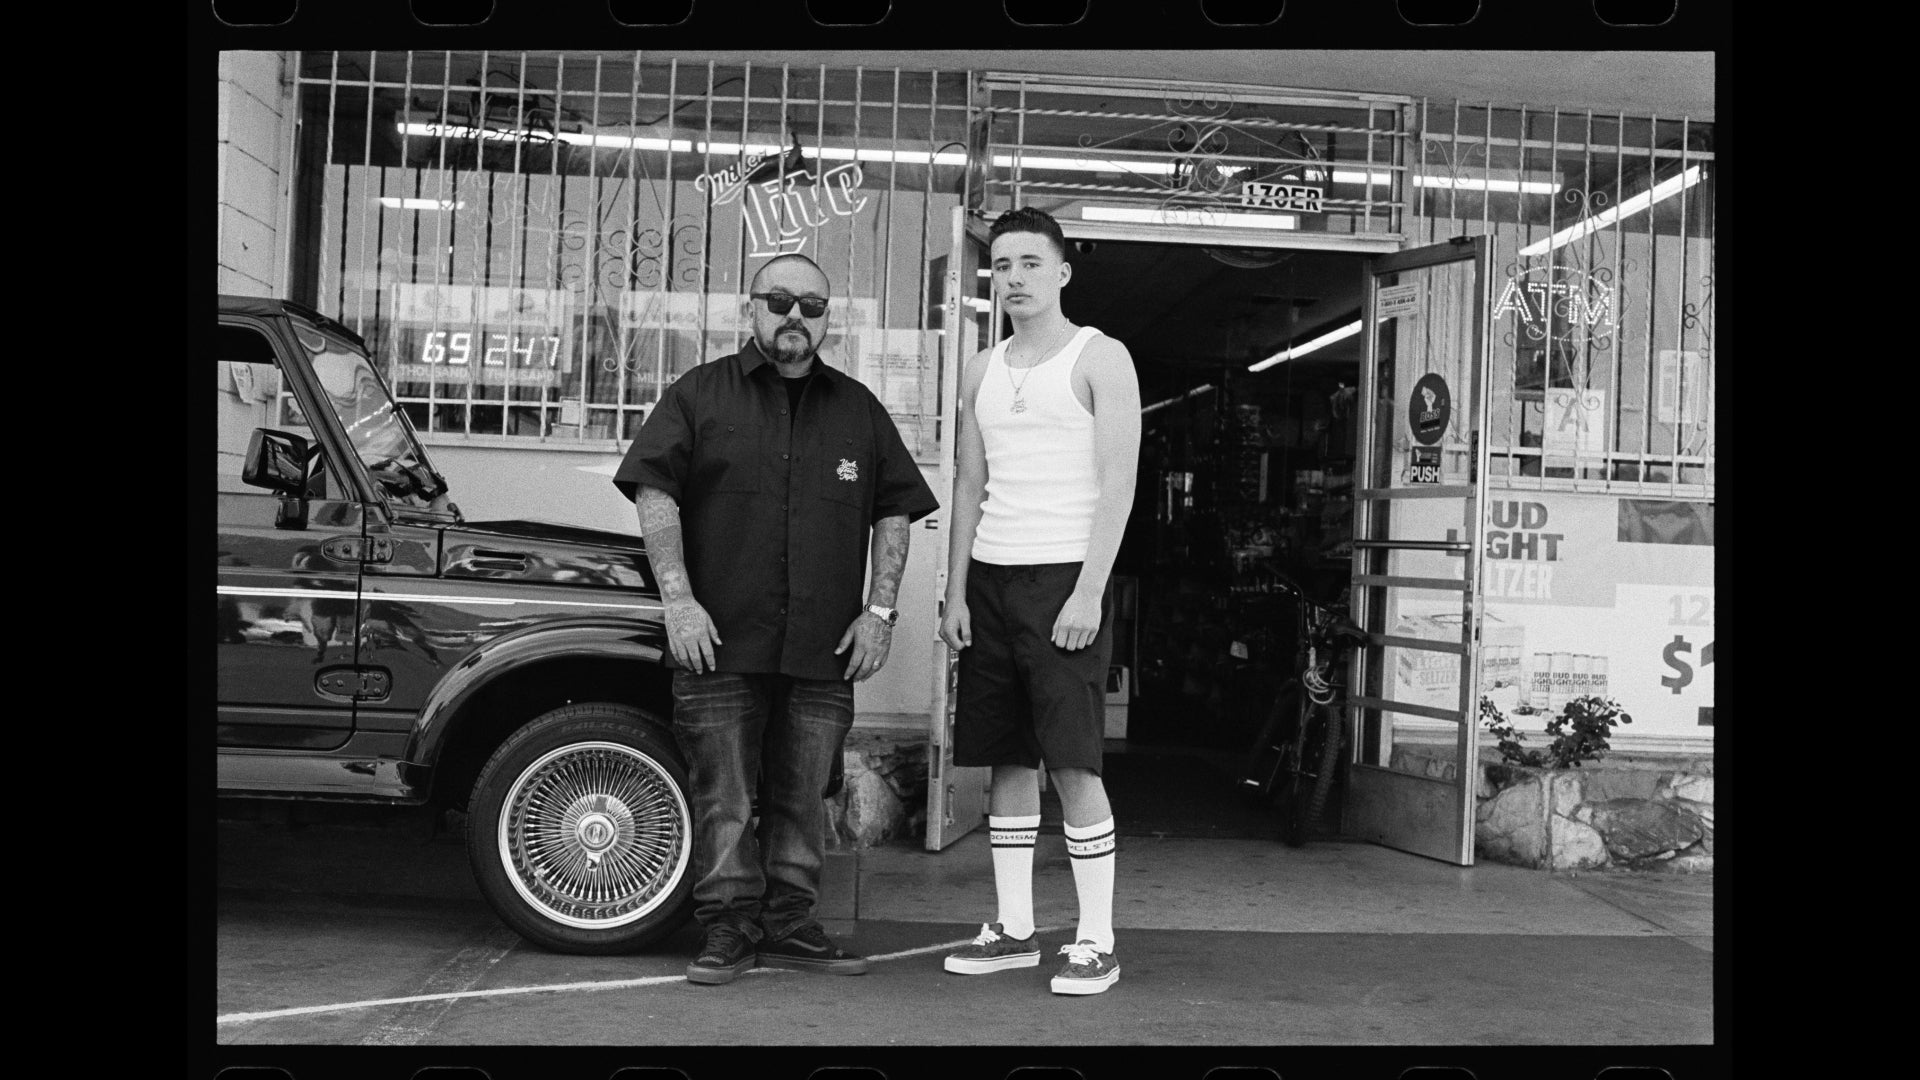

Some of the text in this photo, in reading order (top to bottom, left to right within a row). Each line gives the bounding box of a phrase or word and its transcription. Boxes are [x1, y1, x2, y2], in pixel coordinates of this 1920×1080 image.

[742, 162, 868, 258] Lite
[1493, 277, 1614, 326] ATM
[422, 331, 560, 367] 69 247
[1411, 465, 1440, 482] PUSH
[1446, 528, 1564, 561] LGHT
[1667, 594, 1711, 627] 12
